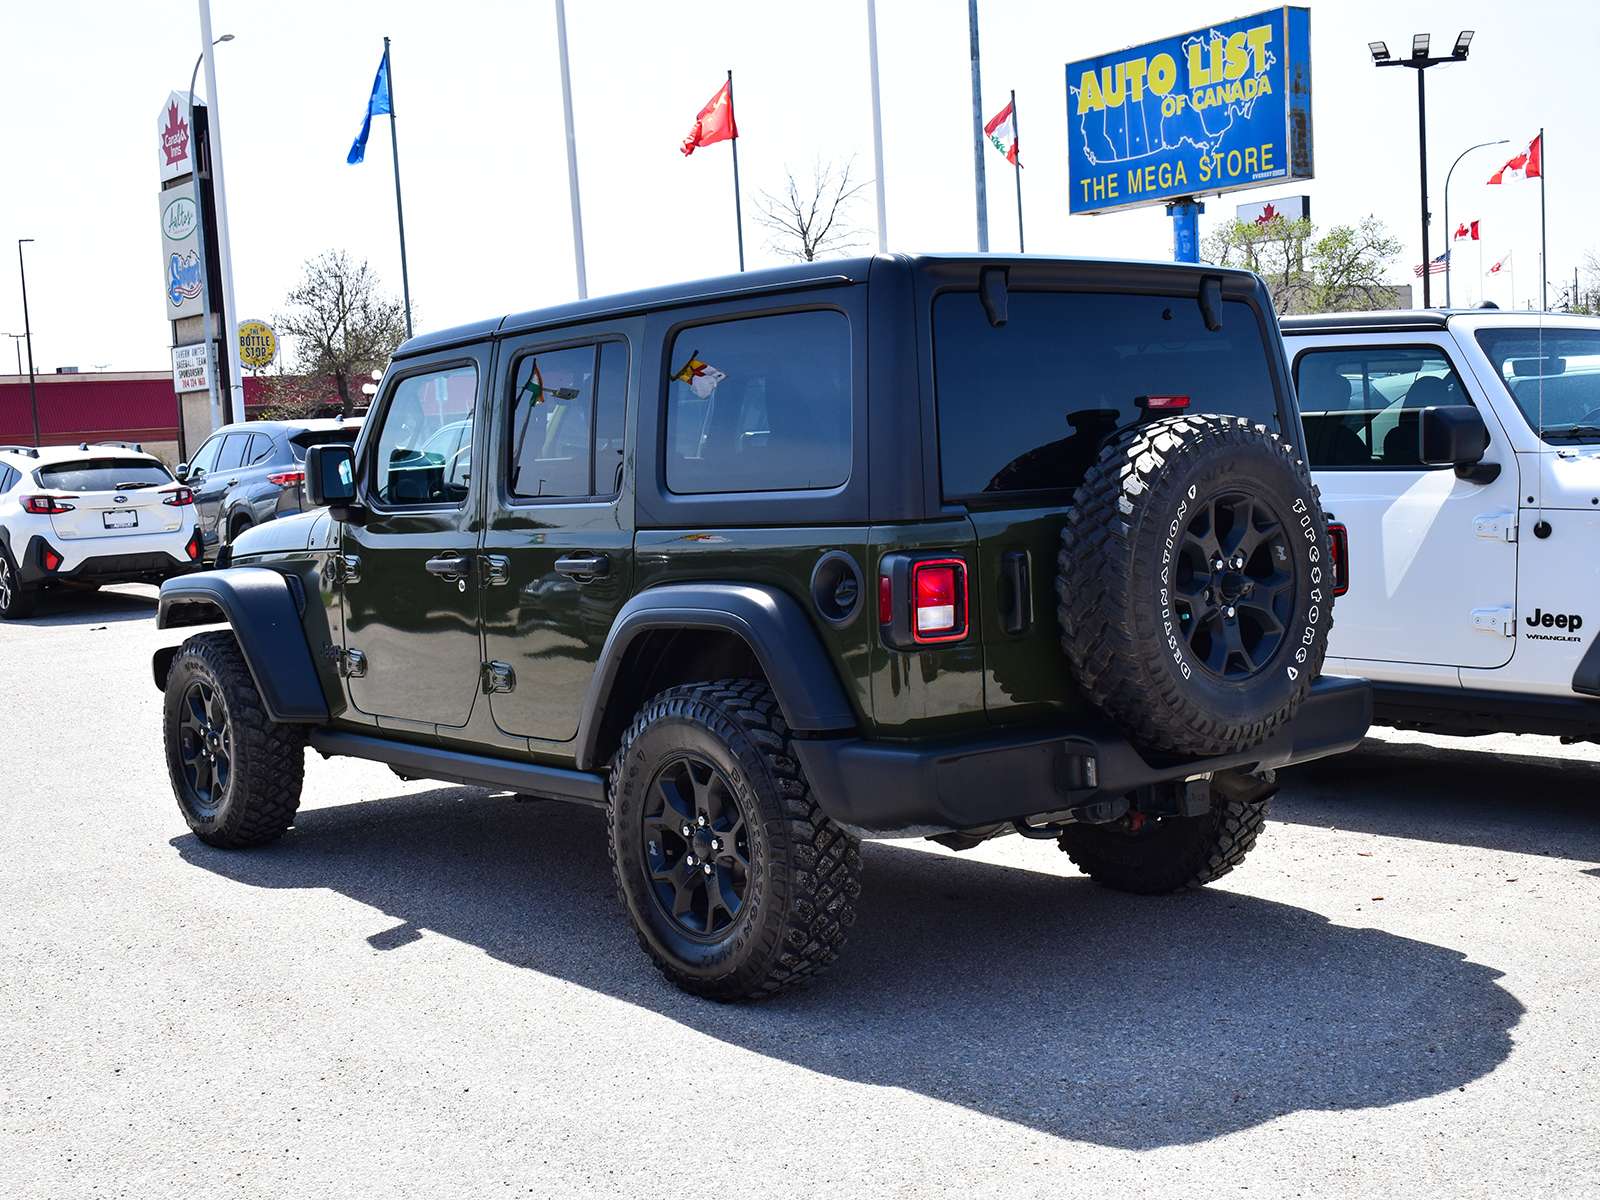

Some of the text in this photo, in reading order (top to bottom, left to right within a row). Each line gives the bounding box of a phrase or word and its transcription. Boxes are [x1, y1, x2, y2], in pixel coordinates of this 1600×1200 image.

[1077, 24, 1272, 115] AUTO LIST
[1161, 75, 1272, 118] OF CANADA
[1080, 144, 1274, 202] THE MEGA STORE
[240, 336, 270, 347] BOTTLE
[245, 347, 267, 358] STOP
[1161, 500, 1192, 680] DESTINATION
[1525, 633, 1581, 642] WRANGLER
[1526, 608, 1583, 633] Jeep
